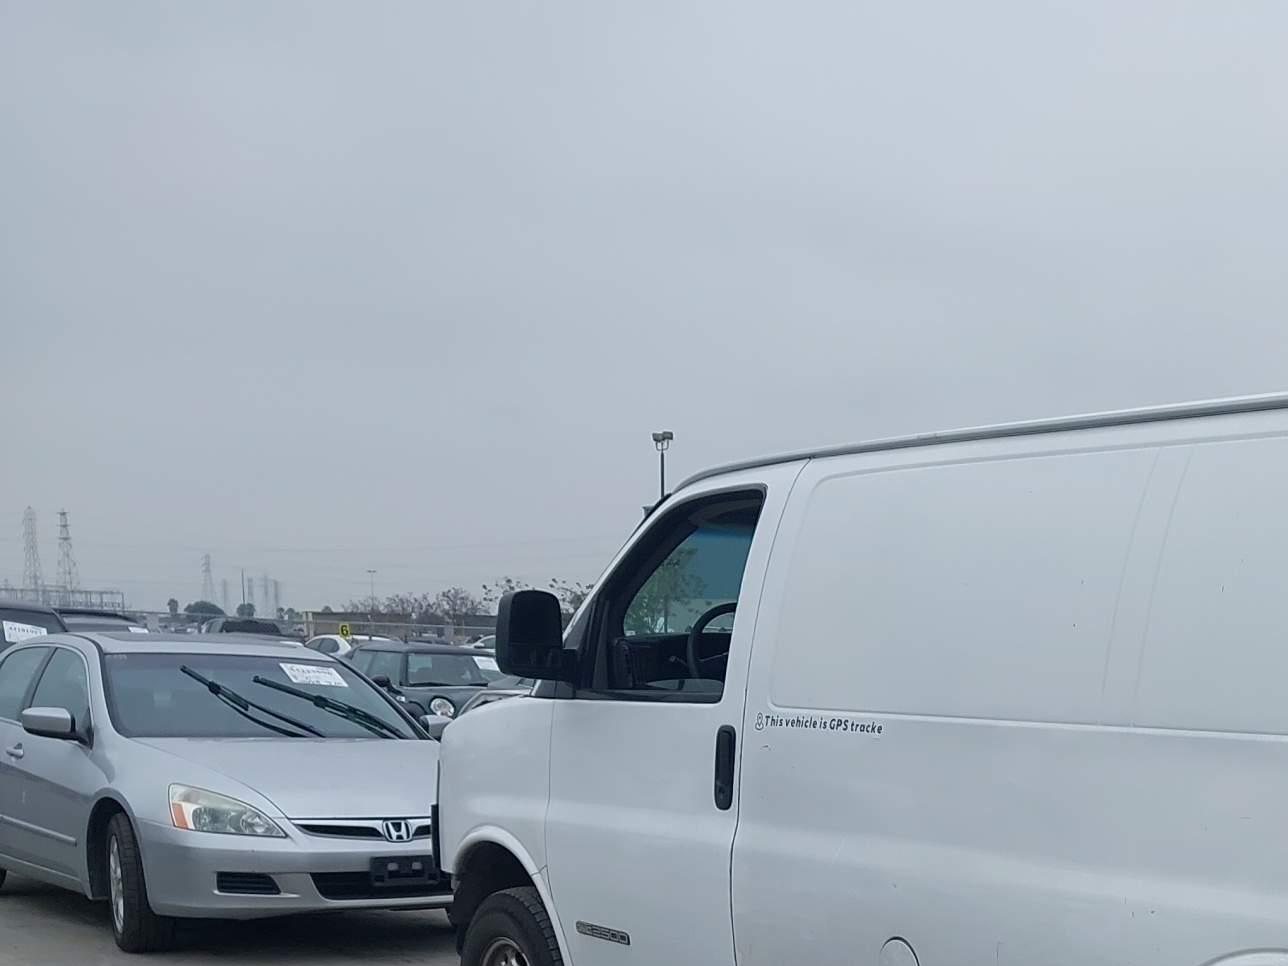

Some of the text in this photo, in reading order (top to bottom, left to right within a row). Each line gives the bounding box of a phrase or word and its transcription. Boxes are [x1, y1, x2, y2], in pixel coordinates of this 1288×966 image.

[765, 715, 883, 734] This vehicle is GPS tracke
